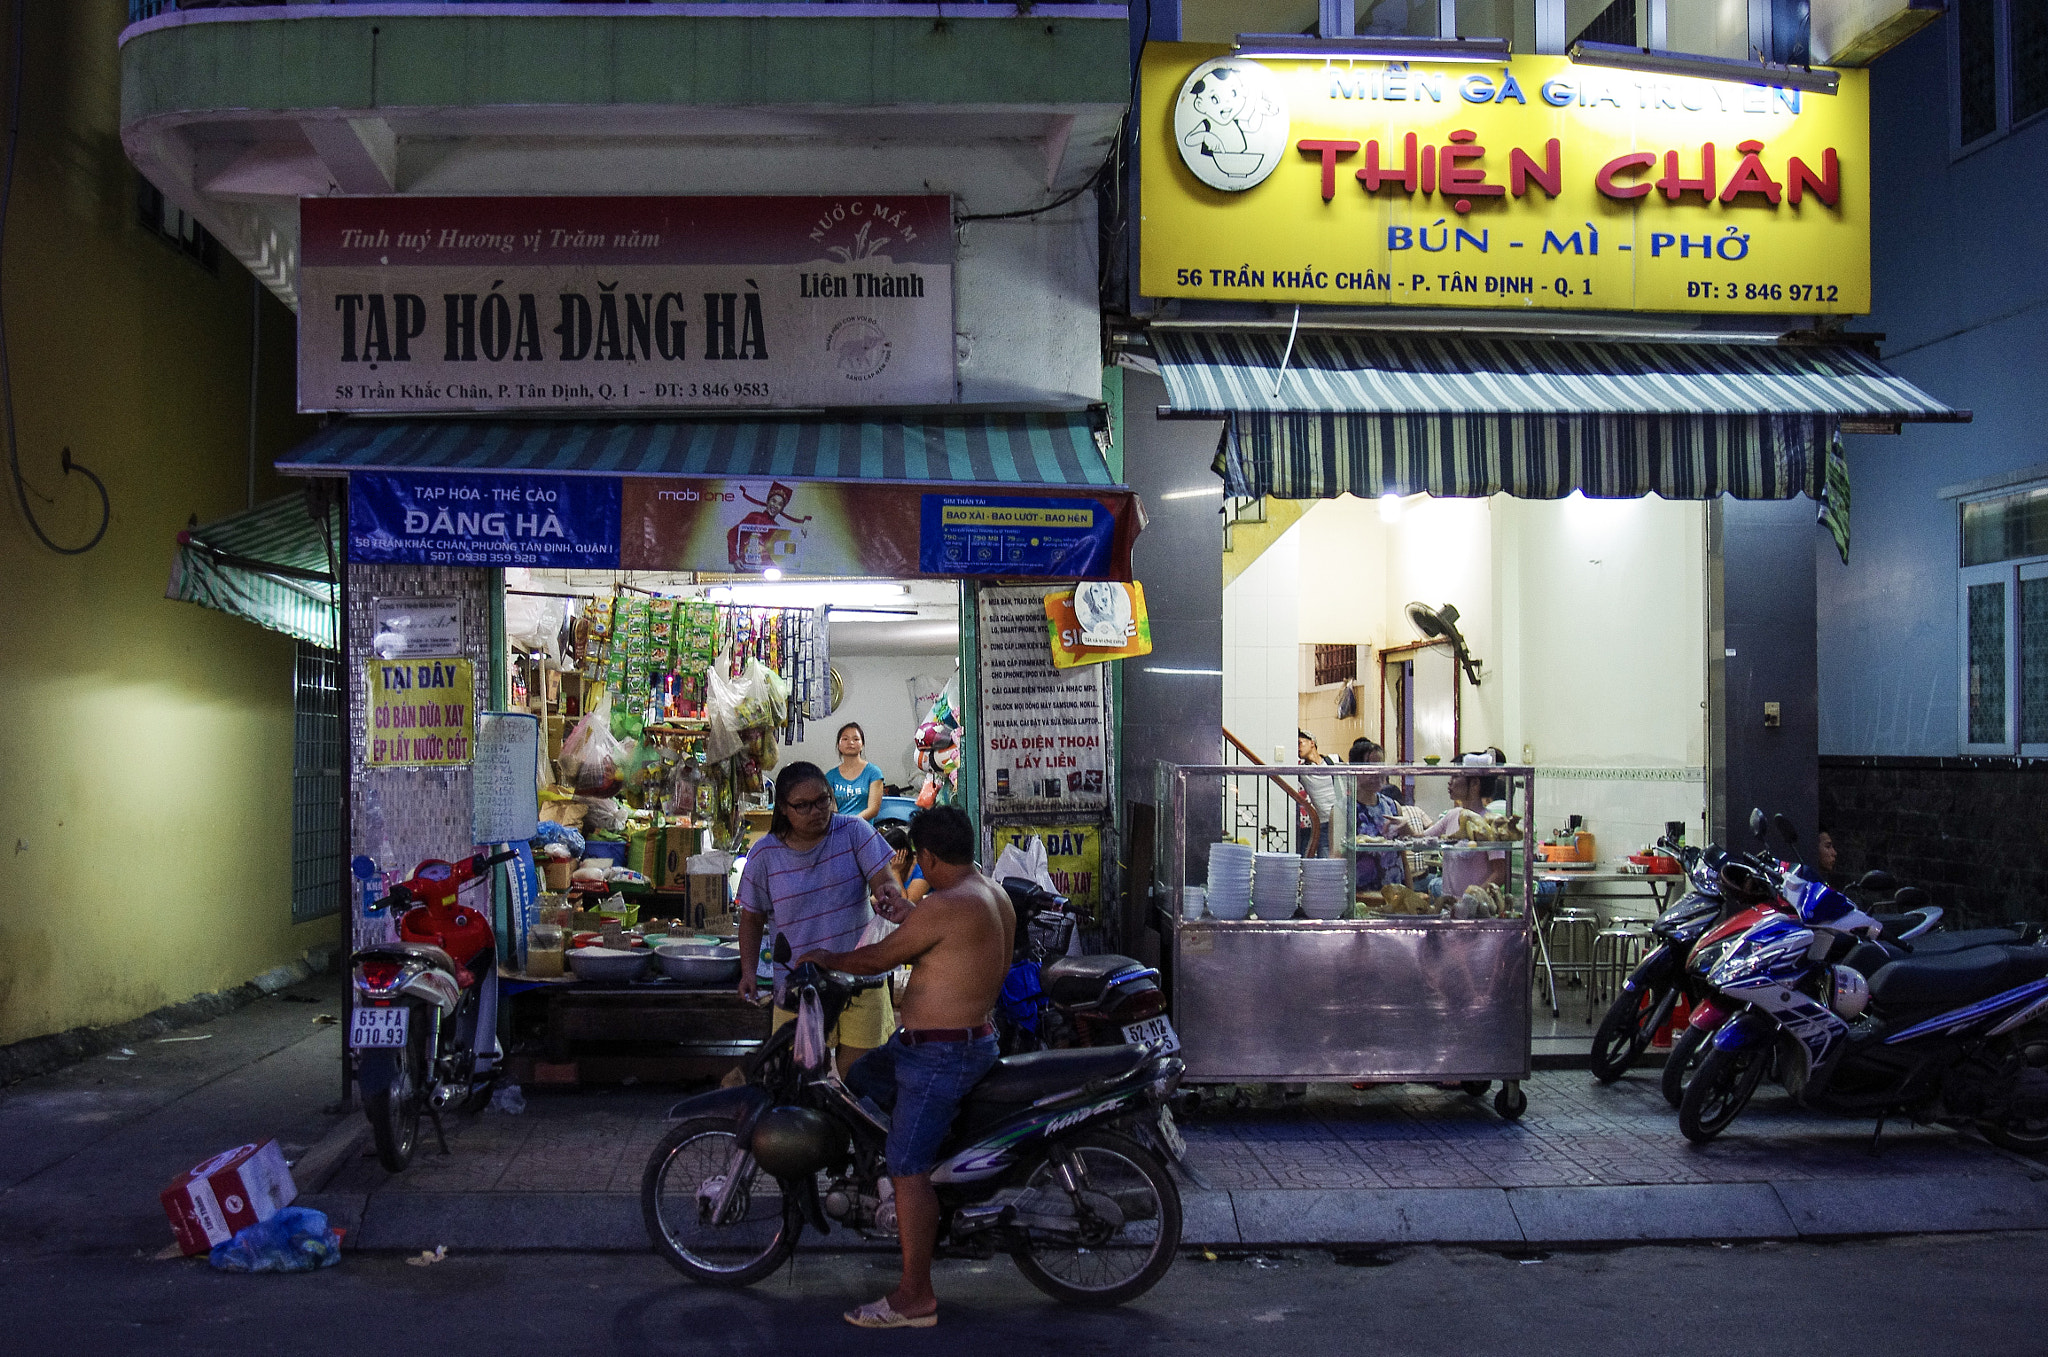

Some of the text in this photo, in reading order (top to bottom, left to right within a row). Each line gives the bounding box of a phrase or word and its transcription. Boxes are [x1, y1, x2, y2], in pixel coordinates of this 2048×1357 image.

[1459, 67, 1527, 104] GÀ
[1541, 79, 1621, 109] GIA
[1297, 129, 1840, 212] THIỆN CHÂN
[397, 228, 432, 252] tuý
[438, 228, 516, 252] Hương
[523, 228, 542, 252] vị
[550, 228, 606, 248] Trăm
[613, 228, 661, 248] năm
[1387, 219, 1489, 253] BÚN
[1542, 222, 1599, 256] MÌ
[1651, 226, 1750, 261] PHỞ
[800, 272, 924, 298] Liên Thành
[1177, 268, 1203, 287] 56
[1210, 263, 1265, 288] TRẦN
[1273, 264, 1329, 289] KHẮC
[1335, 269, 1391, 291] CHÂN
[1412, 274, 1431, 291] P.
[1438, 271, 1478, 293] TÂN
[1485, 275, 1533, 297] ĐỊNH
[1554, 278, 1574, 297] Q.
[1582, 279, 1593, 295] 1
[1687, 281, 1839, 302] ĐT: 3 846 9712
[335, 279, 769, 371] TẠP HÓA ĐĂNG HÀ
[336, 380, 769, 402] 58 Trần Khắc Chân, P. Tân Định, Q. 1 ĐT: 3 846 9583
[414, 485, 558, 503] TẠP HÓA THẺ CÀO
[404, 505, 565, 538] ĐĂNG HÀ
[946, 511, 967, 520] BAO
[991, 512, 1012, 521] BAO
[1045, 514, 1065, 522] BAO
[489, 553, 511, 563] 359
[381, 661, 457, 694] TẠI ĐÂY
[392, 702, 416, 729] BÁN
[419, 700, 441, 728] DỪA
[444, 704, 465, 728] XAY
[373, 733, 387, 762] ÉP
[390, 728, 410, 761] LẤY
[413, 733, 444, 761] NƯỚC
[991, 734, 1099, 752] SỬA ĐIỆN THOẠI
[1016, 751, 1077, 768] LẤY LIỀN
[1047, 829, 1085, 856] ĐÂY
[1073, 871, 1092, 894] XAY
[359, 1010, 402, 1027] 65-FA
[355, 1028, 404, 1045] 010.93
